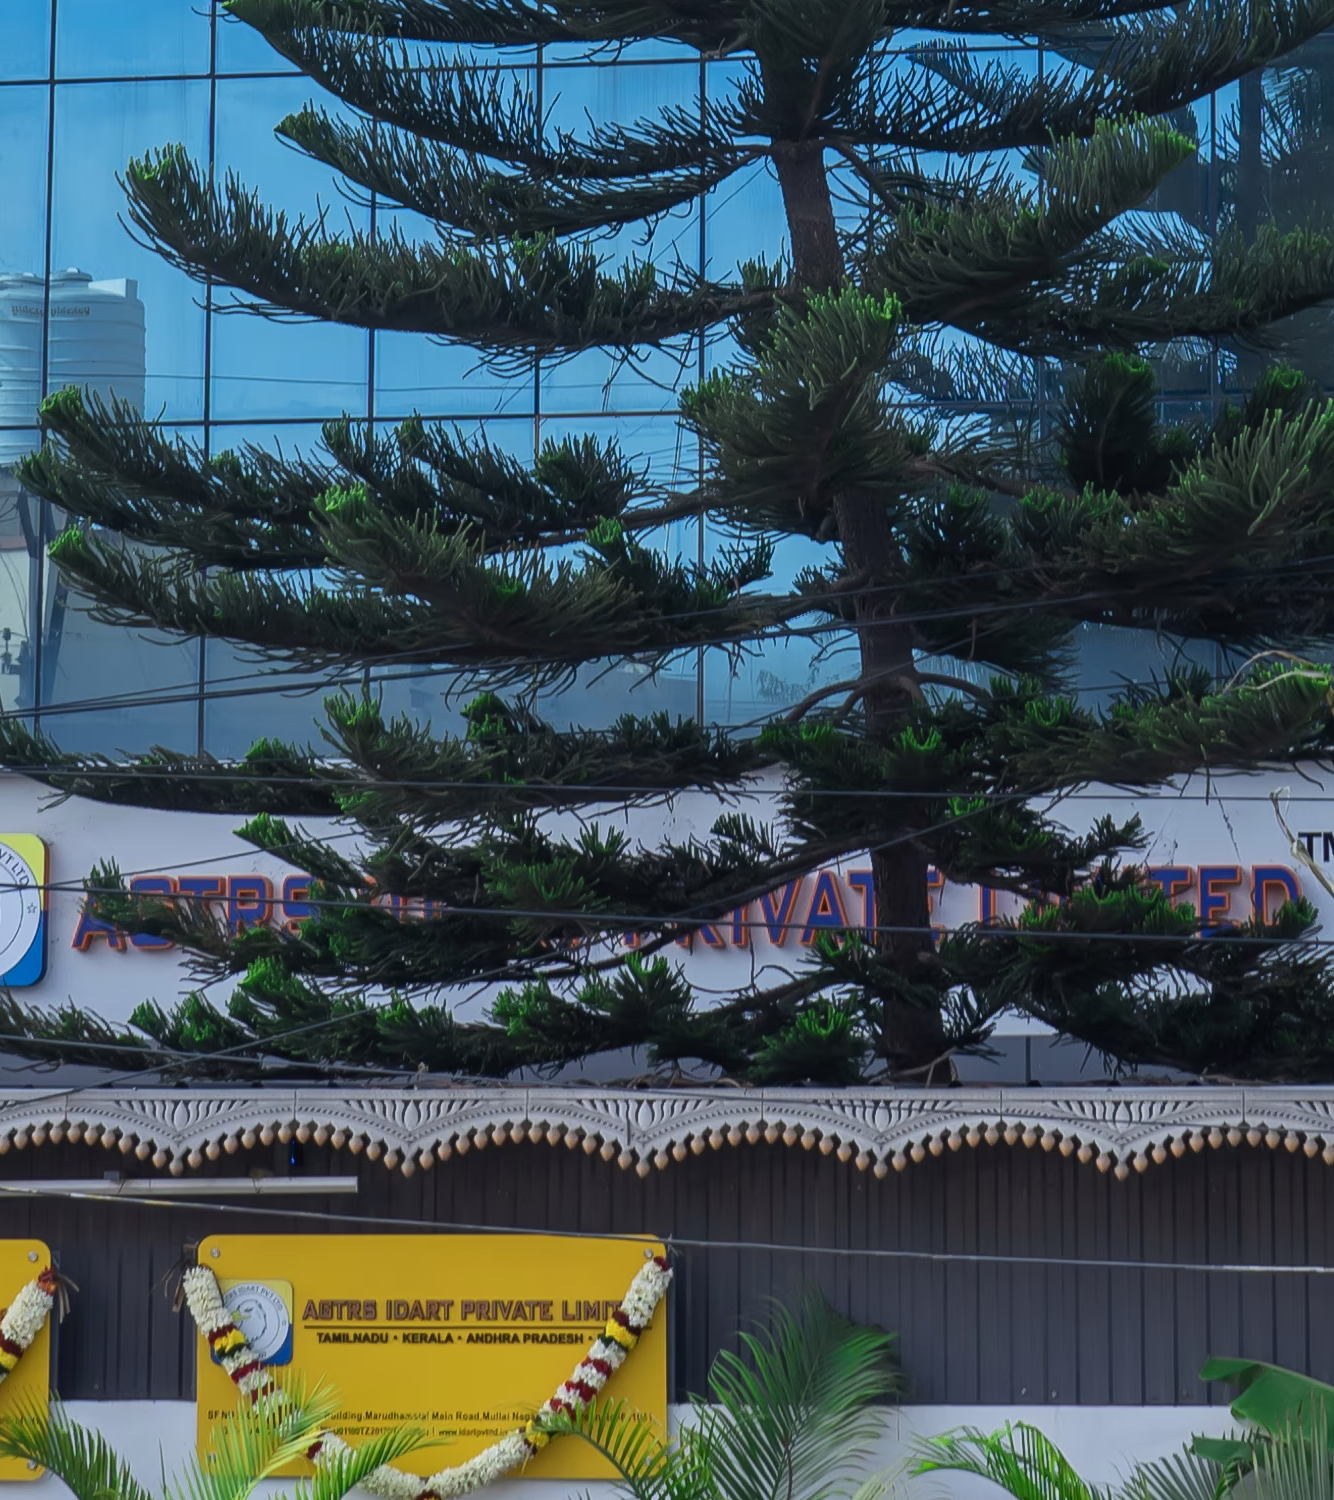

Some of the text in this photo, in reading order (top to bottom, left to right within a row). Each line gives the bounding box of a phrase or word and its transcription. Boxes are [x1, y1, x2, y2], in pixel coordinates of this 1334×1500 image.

[11, 860, 31, 887] LTD
[302, 1299, 623, 1321] AGTRS IDART PRIVATE LIMIT
[316, 1332, 584, 1345] TAMILNADU KERALA ANDHRA PRADESH
